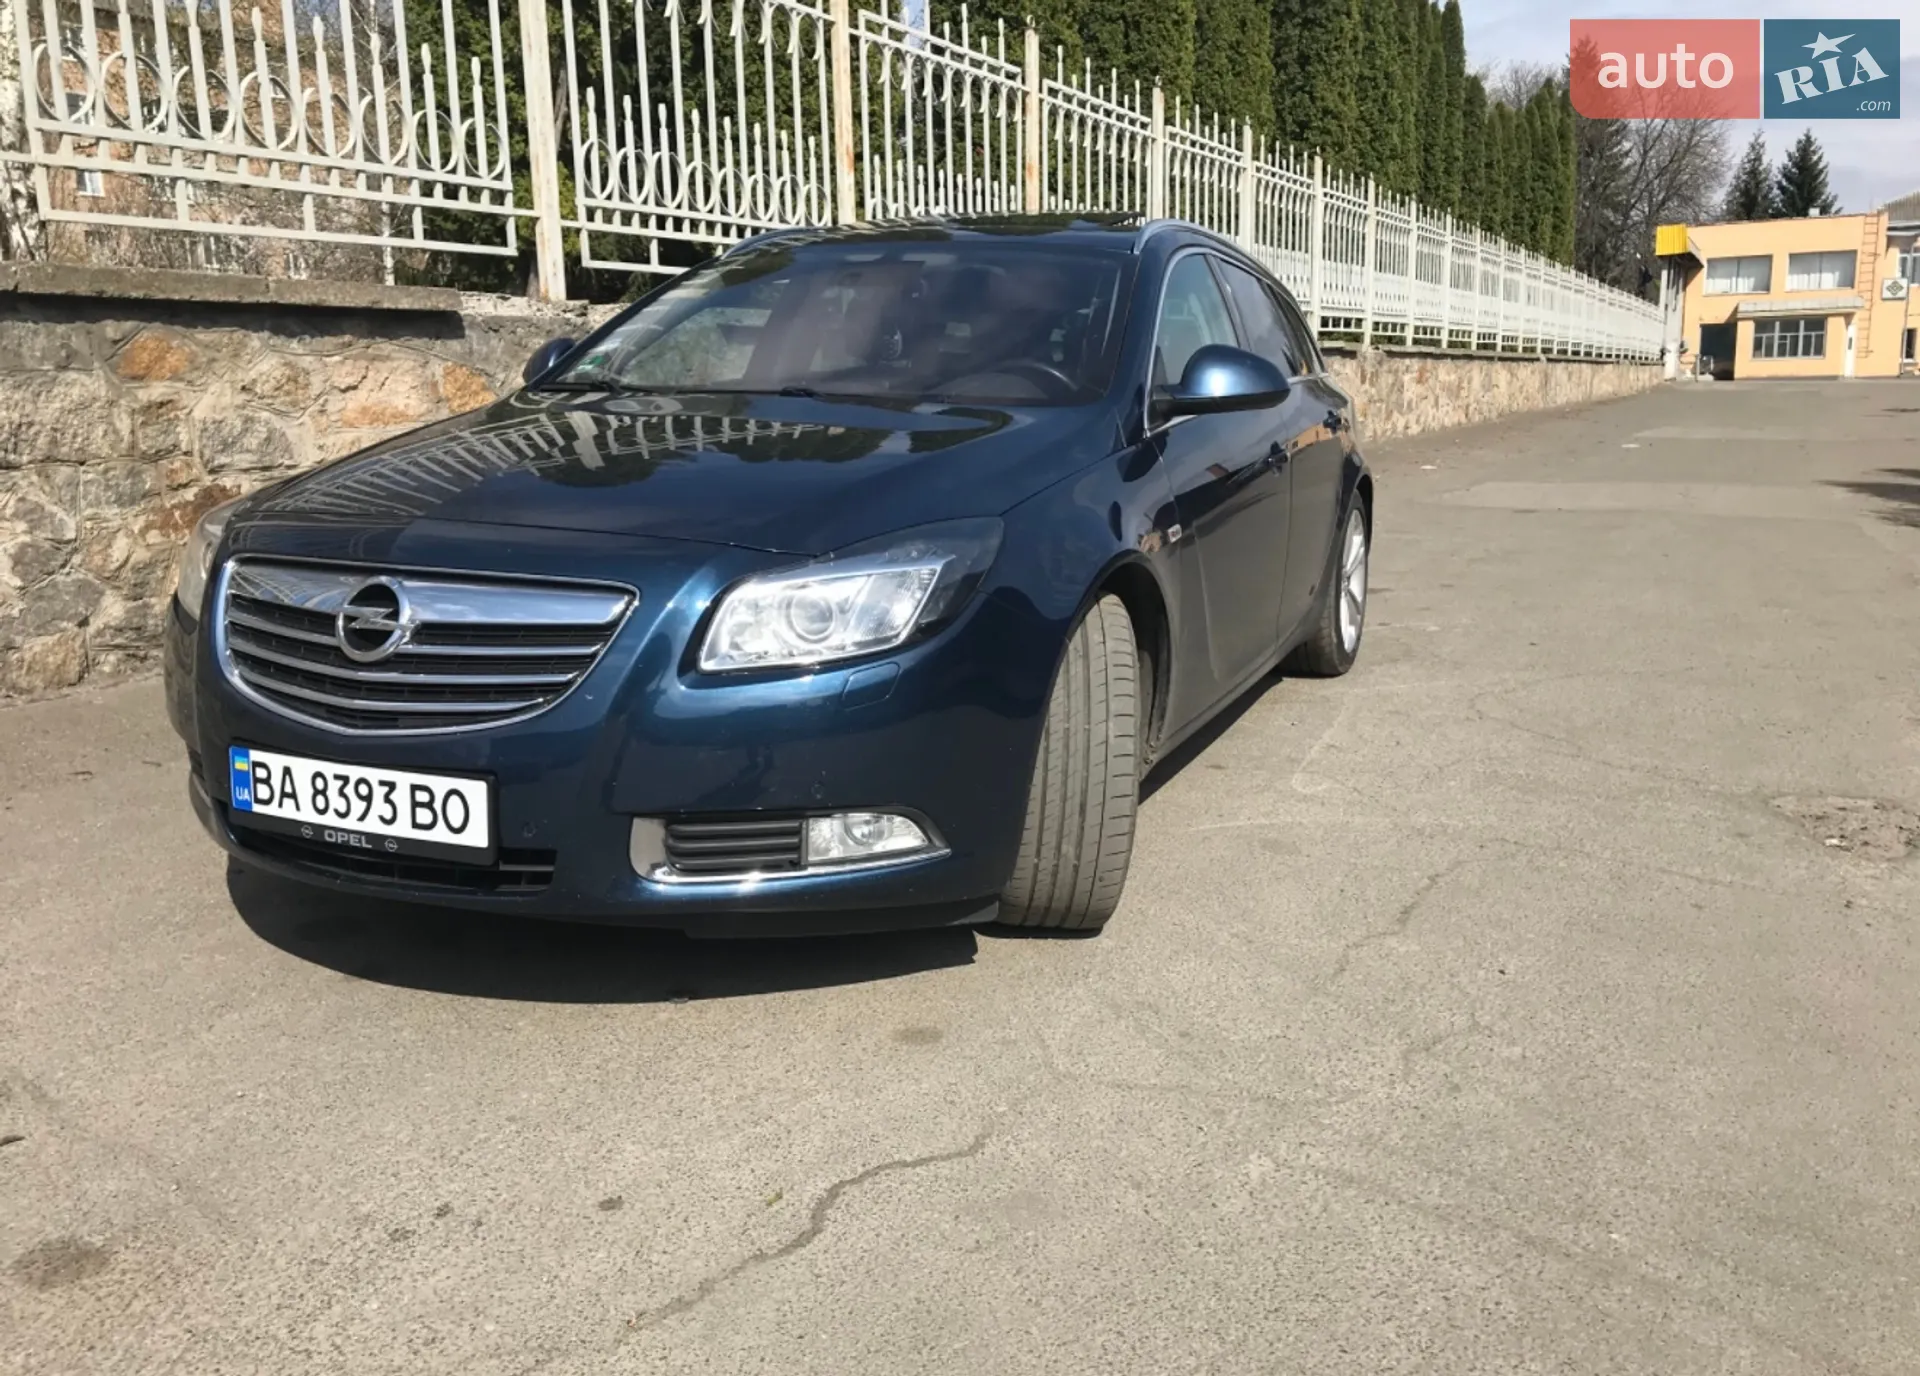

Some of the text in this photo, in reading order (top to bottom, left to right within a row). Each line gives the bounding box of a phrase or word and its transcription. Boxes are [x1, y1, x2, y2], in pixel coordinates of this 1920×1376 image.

[235, 787, 250, 801] UA
[251, 761, 470, 834] BA 8393 BO
[324, 829, 372, 848] OPEL
